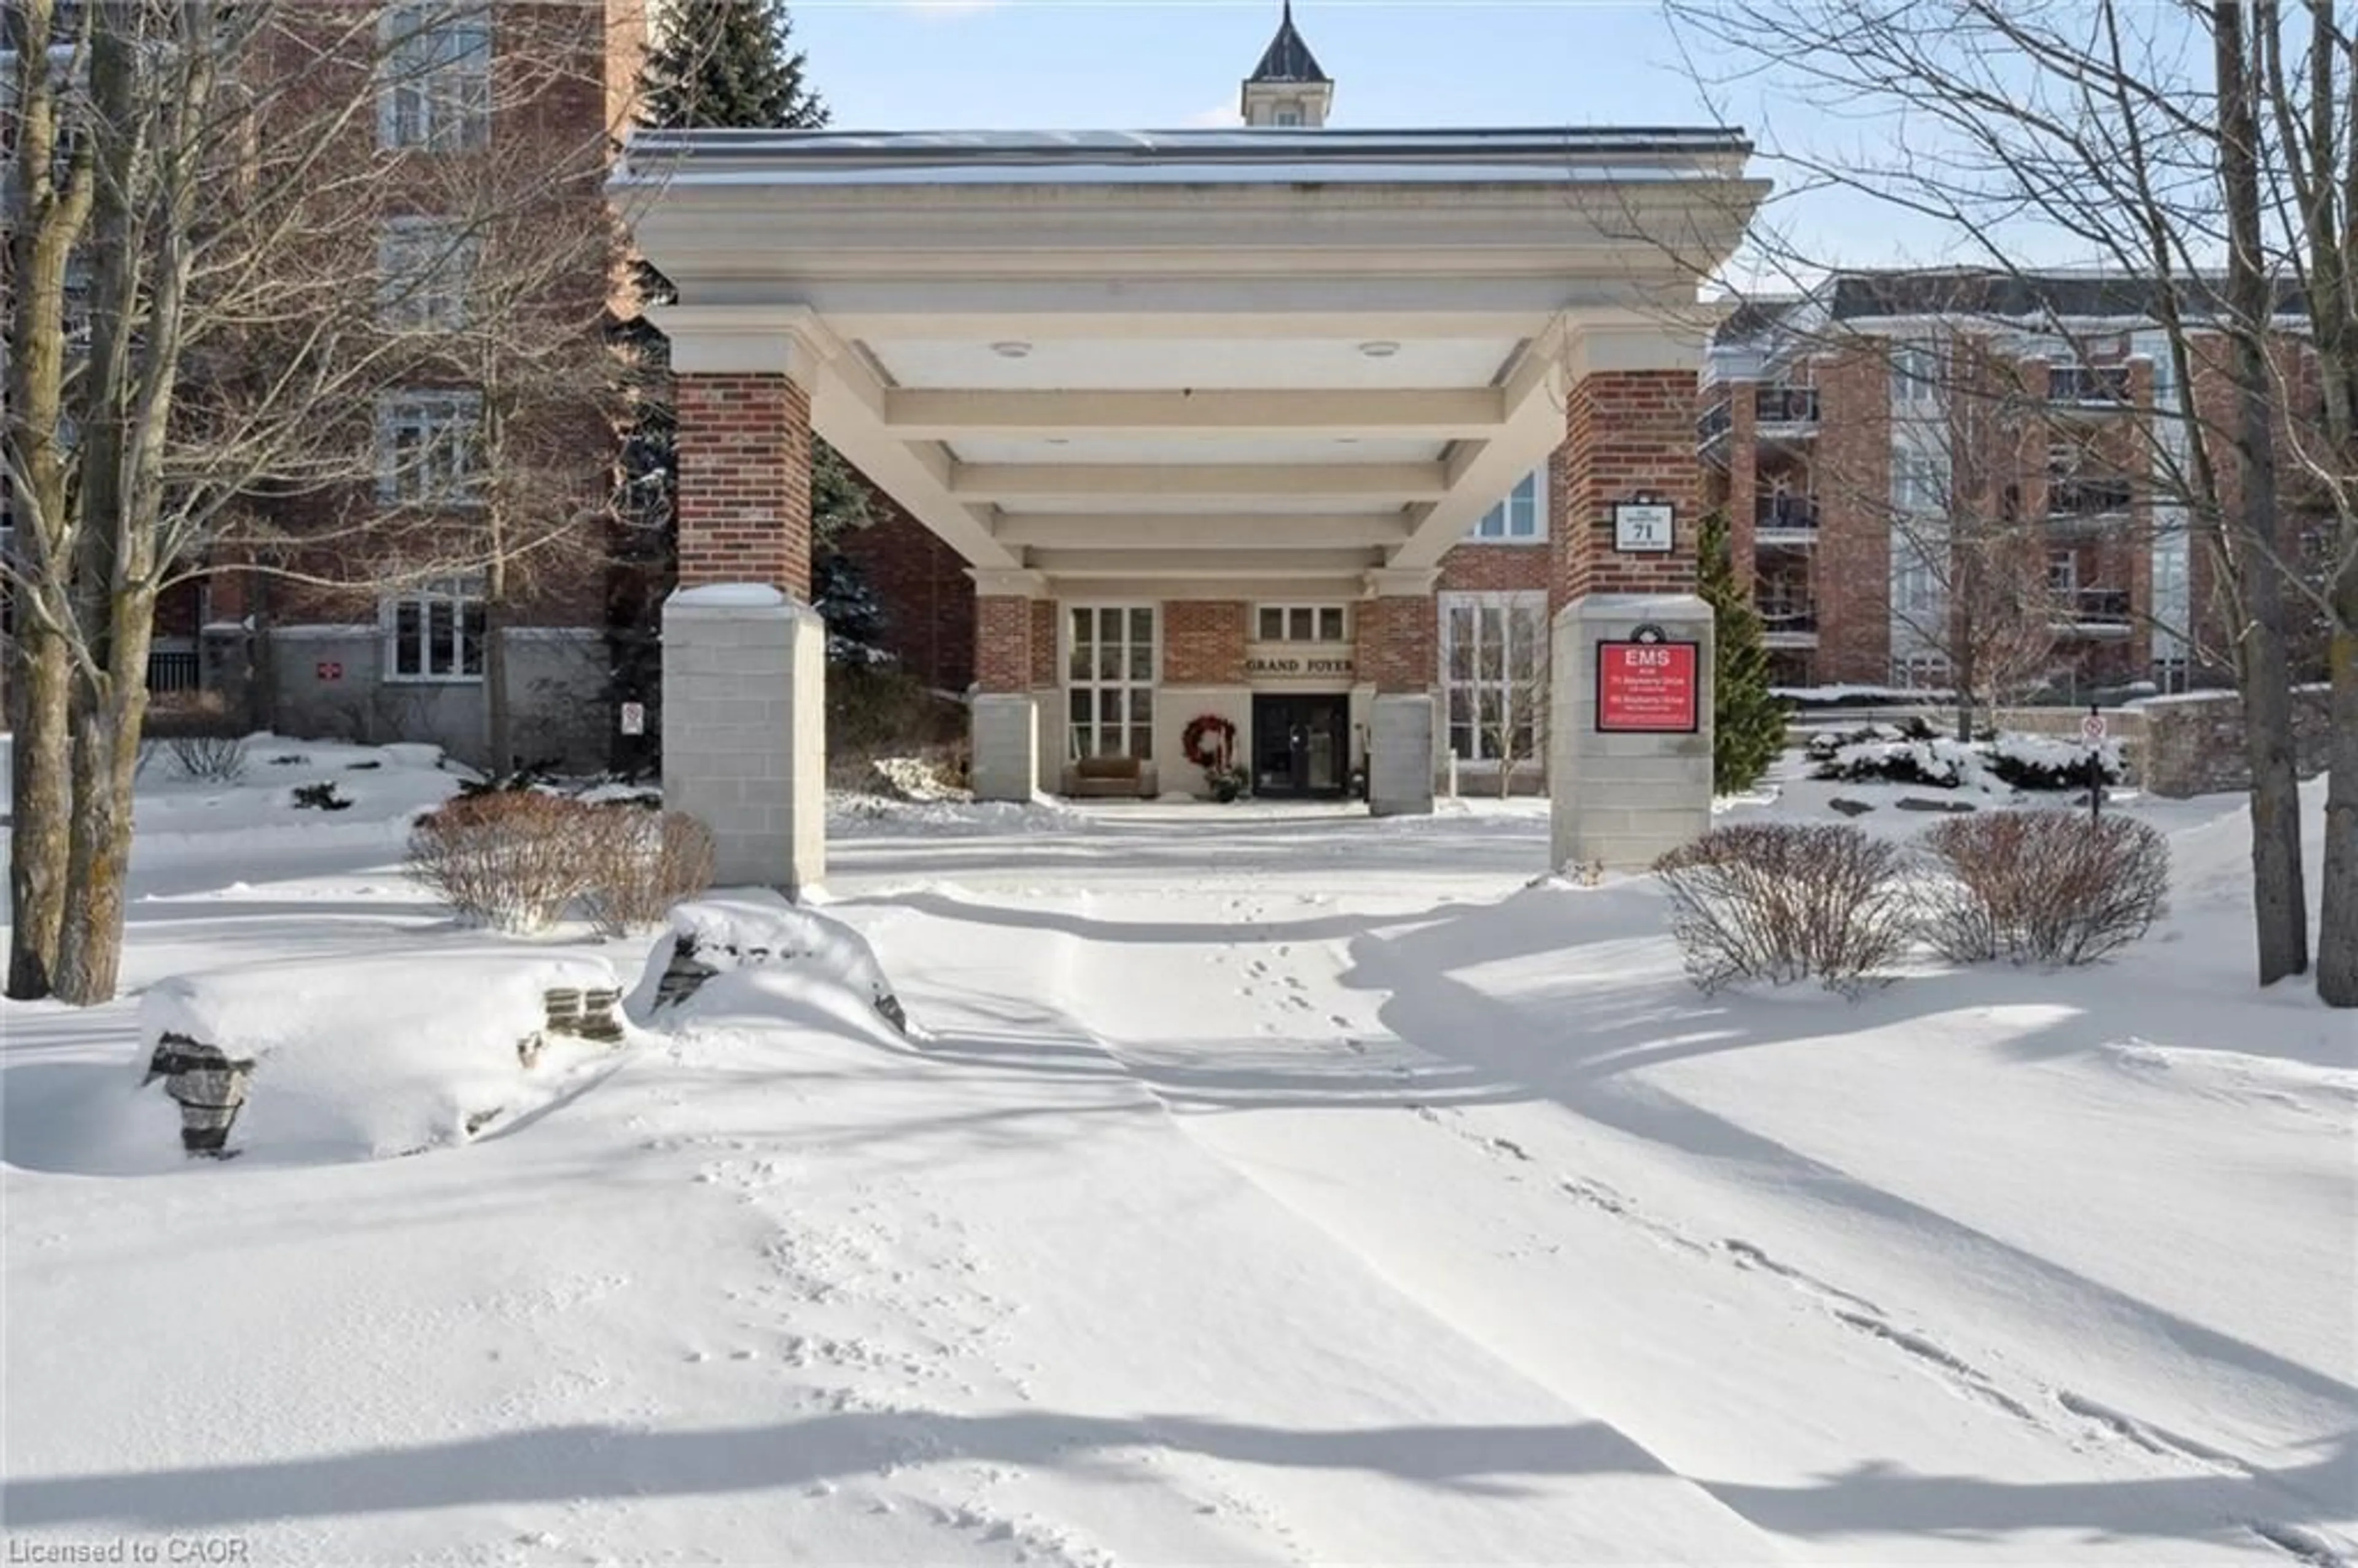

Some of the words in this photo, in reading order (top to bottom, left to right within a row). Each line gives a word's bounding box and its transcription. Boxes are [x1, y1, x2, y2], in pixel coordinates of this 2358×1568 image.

[1633, 524, 1652, 539] 71
[1625, 648, 1671, 666] EMS
[1245, 659, 1299, 672] GRAND
[1307, 659, 1353, 672] FOYER
